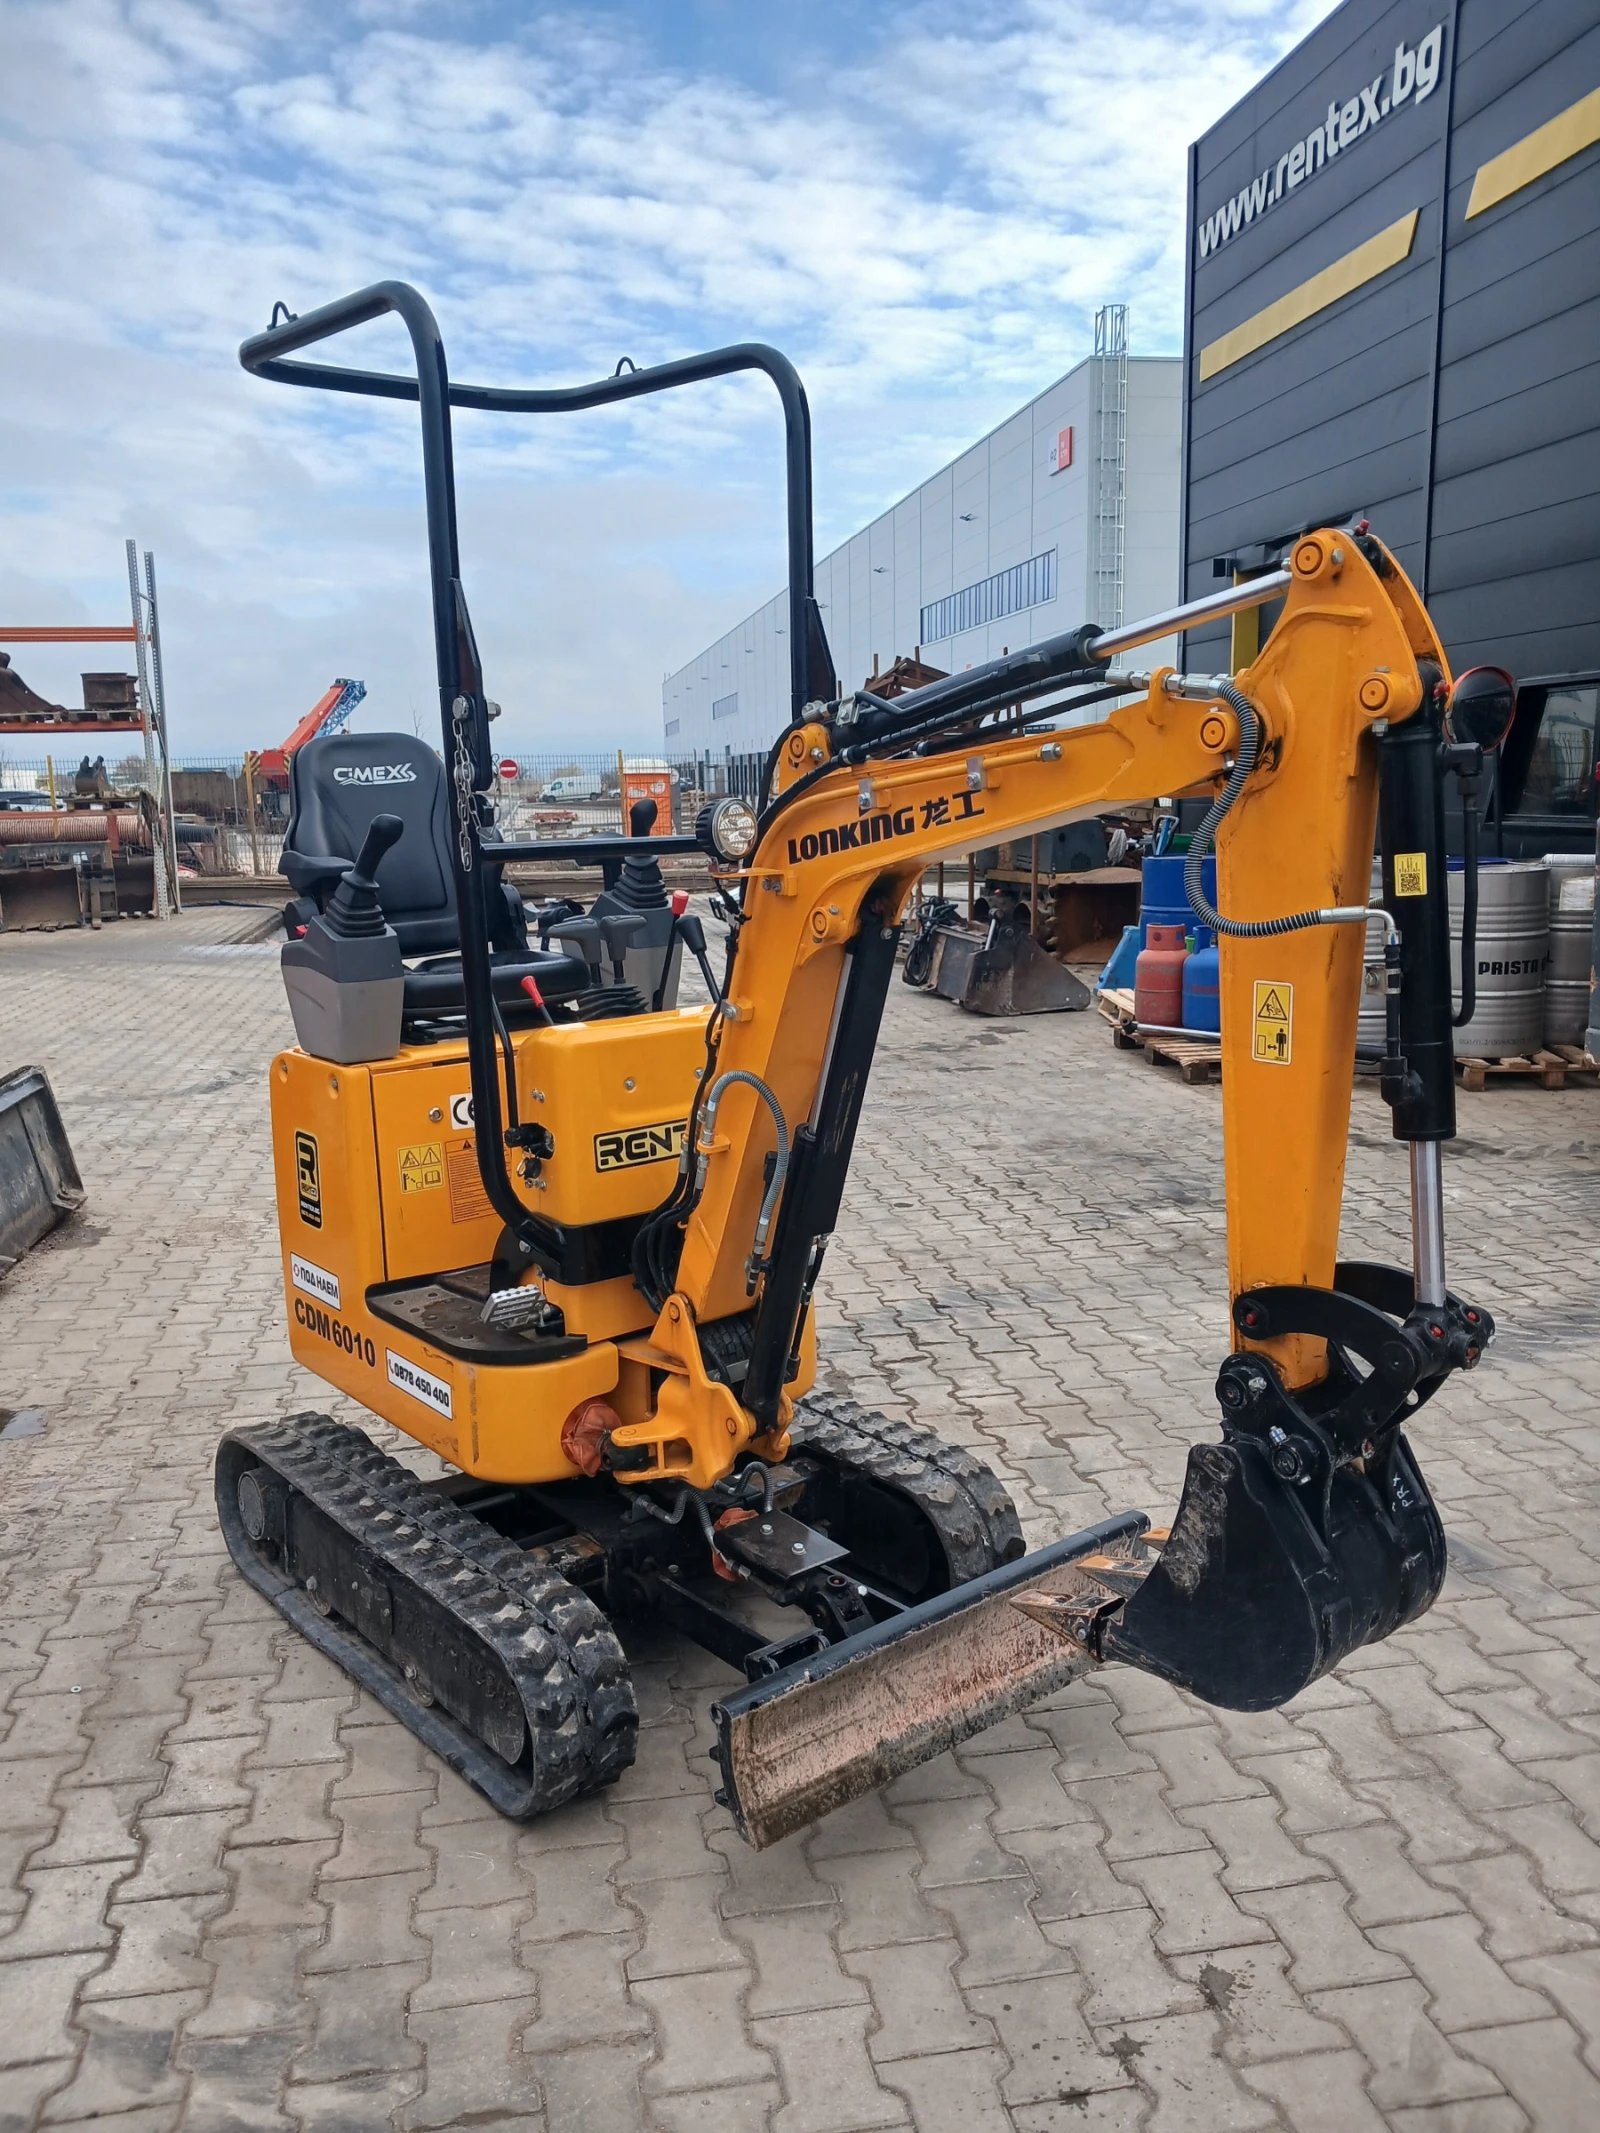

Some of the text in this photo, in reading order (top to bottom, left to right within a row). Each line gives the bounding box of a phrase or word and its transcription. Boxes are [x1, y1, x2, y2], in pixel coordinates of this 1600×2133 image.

[1199, 24, 1442, 257] www.rentex.bg
[788, 789, 985, 865] LONKING 龙工
[1478, 959, 1539, 976] PRISTA
[300, 1266, 338, 1299] ПОД НАЕМ
[295, 1298, 376, 1367] CDM6010
[394, 1362, 450, 1407] 0878 450 400
